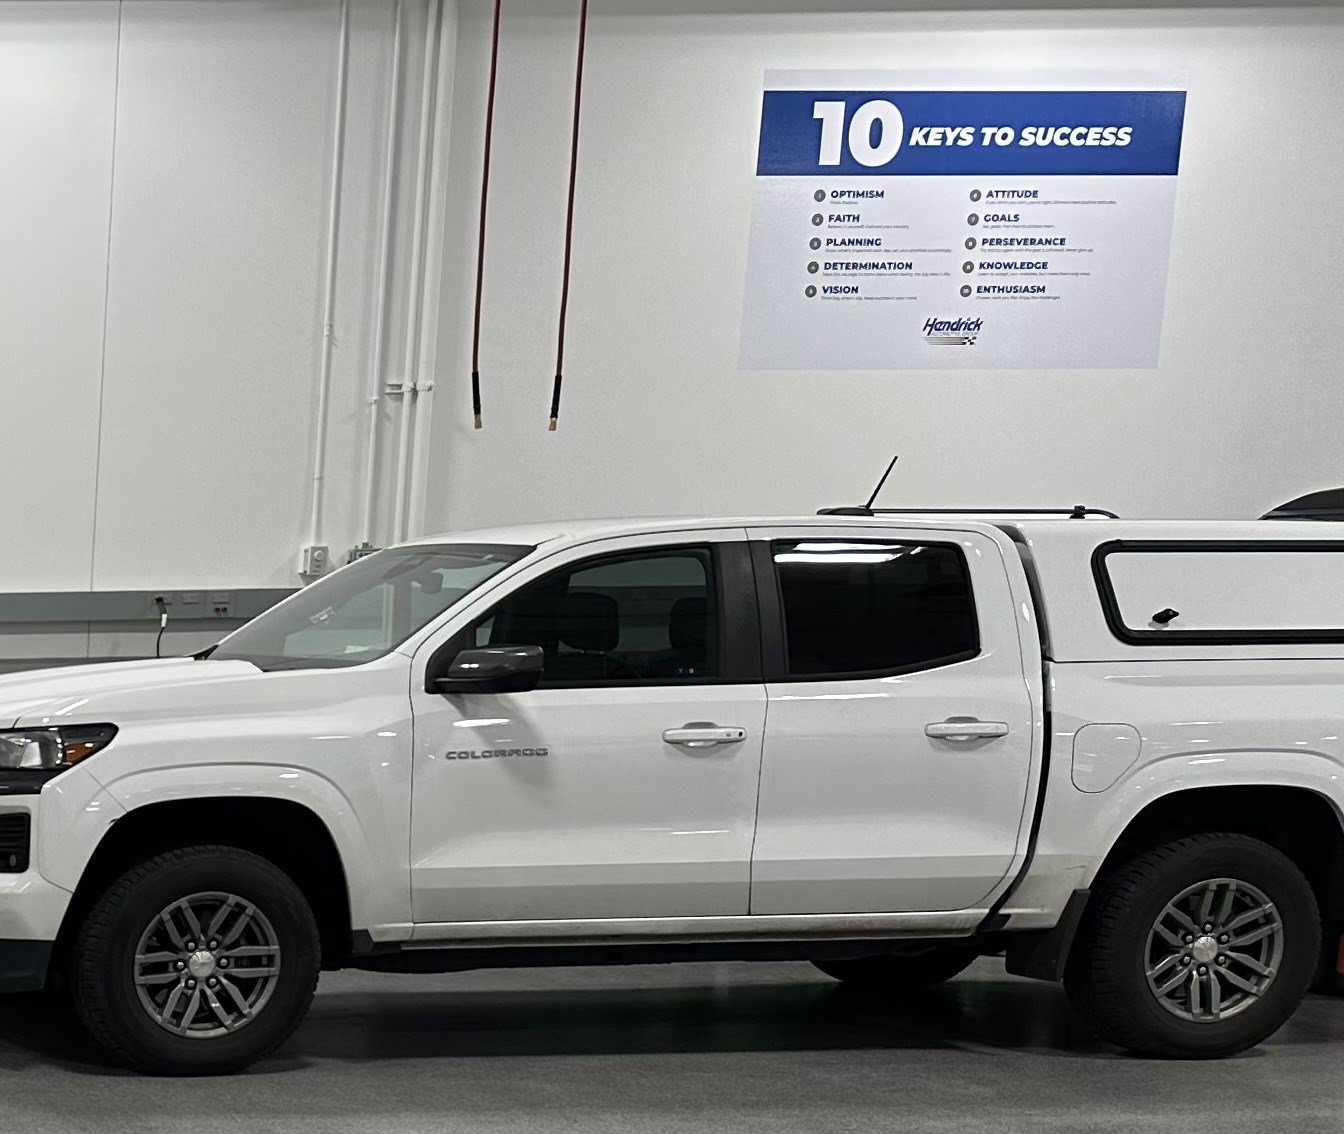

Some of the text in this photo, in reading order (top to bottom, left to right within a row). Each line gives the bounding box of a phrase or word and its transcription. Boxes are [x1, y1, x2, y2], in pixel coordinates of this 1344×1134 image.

[813, 100, 1132, 167] 10 KEYS TO SUCCESS
[831, 190, 885, 199] OPTIMISM
[986, 190, 1039, 198] ATTITUDE
[828, 214, 860, 222] FAITH
[984, 214, 1020, 222] GOALS
[826, 238, 882, 247] PLANNING
[982, 237, 1066, 246] PERSEVERANCE
[824, 262, 913, 270] DETERMINATION
[979, 261, 1048, 270] KNOWLEDGE
[822, 286, 859, 294] VISION
[976, 285, 1046, 294] ENTHUSIASM
[922, 317, 984, 336] Hendrick
[445, 747, 549, 760] COLORADO
